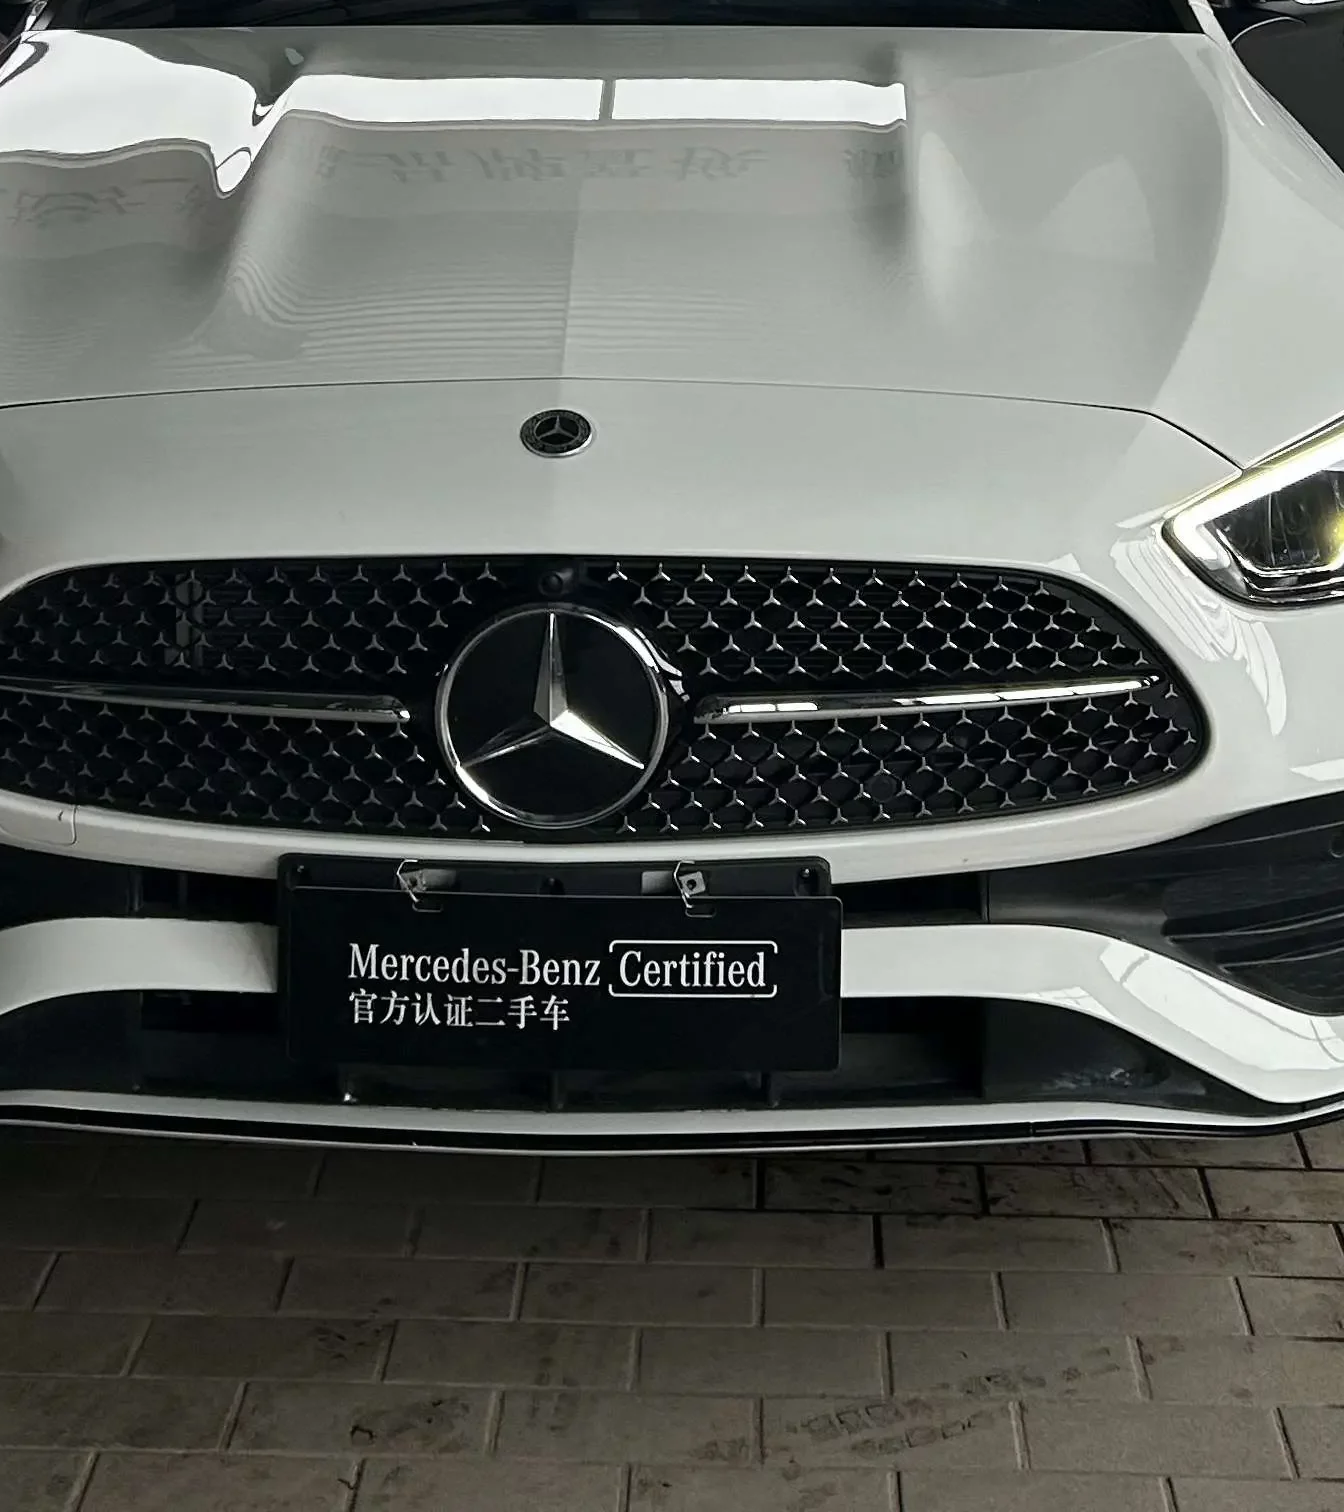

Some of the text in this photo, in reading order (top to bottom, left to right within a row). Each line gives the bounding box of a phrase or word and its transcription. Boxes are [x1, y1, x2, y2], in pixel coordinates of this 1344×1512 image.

[348, 942, 767, 989] Mercedes-Benz Certified
[348, 990, 571, 1031] 官方认证二手车
